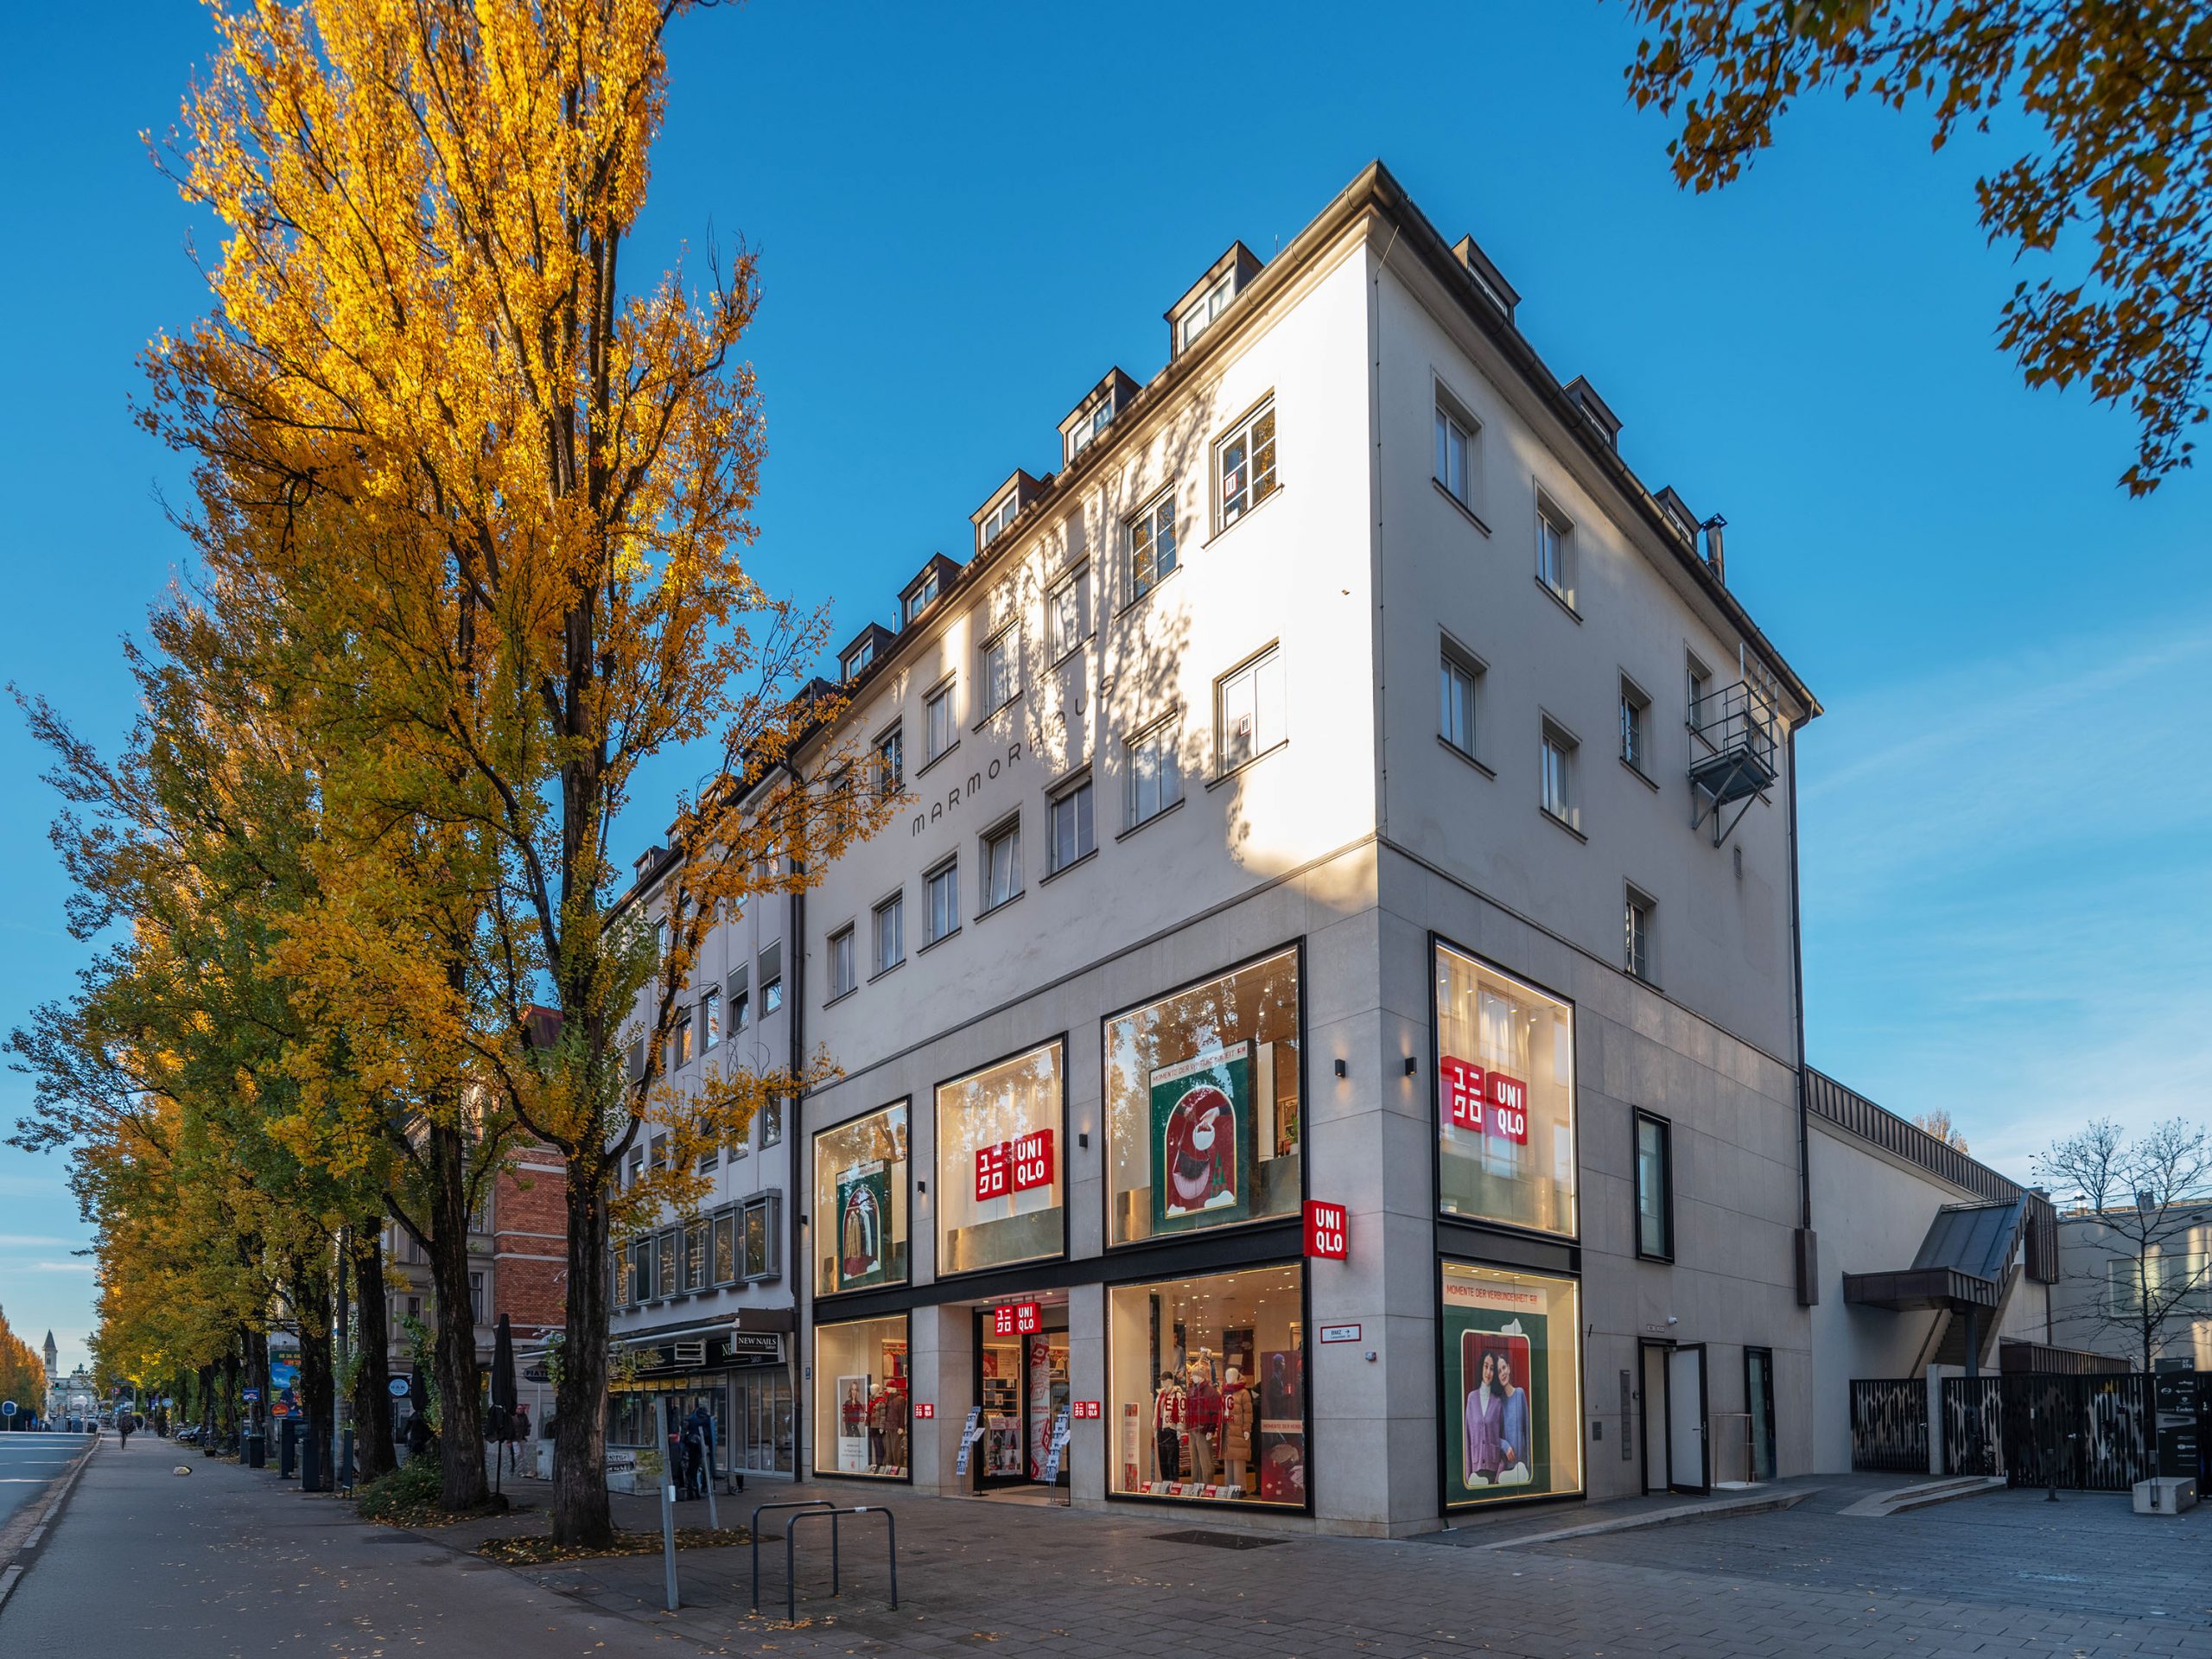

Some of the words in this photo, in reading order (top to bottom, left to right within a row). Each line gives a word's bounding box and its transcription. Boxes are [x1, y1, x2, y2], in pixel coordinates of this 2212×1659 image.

[912, 674, 1115, 836] MARMORHAUS
[1497, 1081, 1521, 1109] UNI
[1497, 1109, 1523, 1135] QLO
[1017, 1138, 1041, 1161] UNI
[1017, 1160, 1045, 1185] QLO
[1316, 1208, 1339, 1230] UNI
[1316, 1230, 1342, 1253] QLO
[1446, 1284, 1474, 1297] MOMENTE
[1475, 1288, 1487, 1298] DER
[1487, 1290, 1528, 1303] VERBUNDENHEIT
[1019, 1306, 1033, 1318] UNI
[1019, 1319, 1033, 1332] QLO
[721, 1343, 732, 1357] NE
